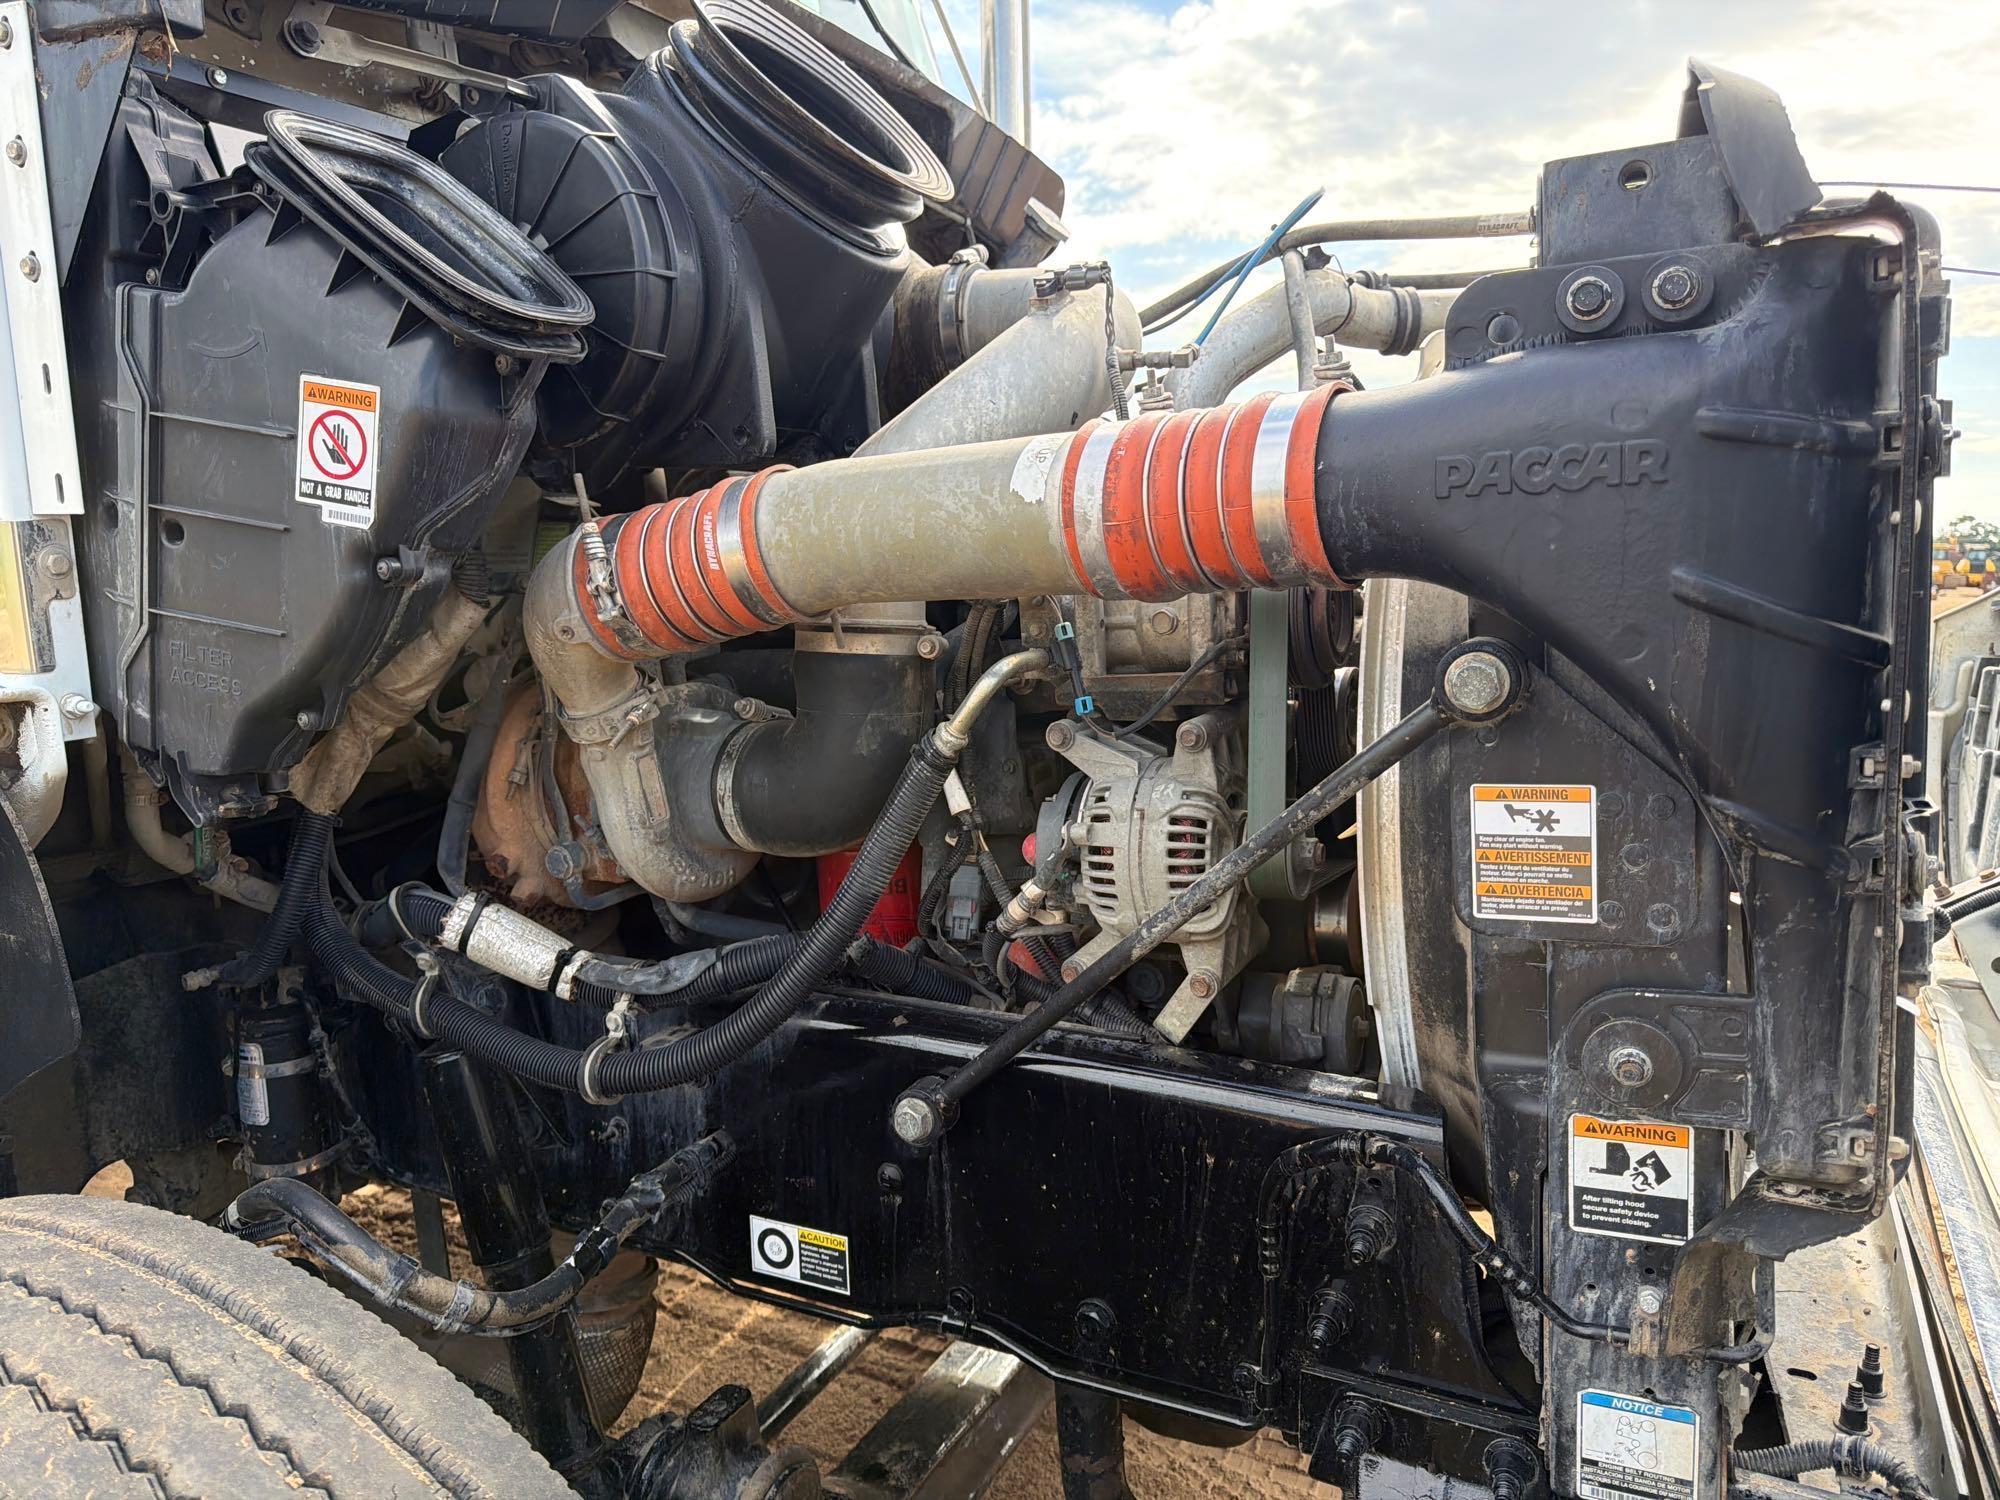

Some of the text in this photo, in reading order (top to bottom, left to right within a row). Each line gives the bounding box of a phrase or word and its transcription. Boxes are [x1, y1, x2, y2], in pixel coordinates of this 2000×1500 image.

[318, 388, 372, 407] WARNING
[1435, 438, 1669, 500] PACCAR
[301, 481, 369, 504] NOT A GRAB HANDLE
[703, 514, 719, 570] DYNACRAFT
[169, 640, 233, 669] FILTER
[170, 666, 243, 696] ACCESS
[1511, 789, 1569, 801] WARNING
[1495, 851, 1589, 864] AVERTISSEMENT
[1501, 884, 1584, 898] ADVERTENCIA
[1598, 1123, 1677, 1142] WARNING
[1582, 1194, 1645, 1208] After tilting hood
[1582, 1204, 1659, 1220] secure safety device
[1591, 1214, 1621, 1224] prevent
[1621, 1218, 1652, 1228] closing.
[807, 1232, 845, 1249] CAUTION
[1612, 1398, 1664, 1417] NOTICE
[1581, 1472, 1612, 1485] PARCOURS
[1598, 1461, 1676, 1483] ENGINE BELT ROUTING
[1634, 1477, 1657, 1487] BANDA
[1657, 1481, 1666, 1489] DE
[1667, 1483, 1691, 1494] MOTOR
